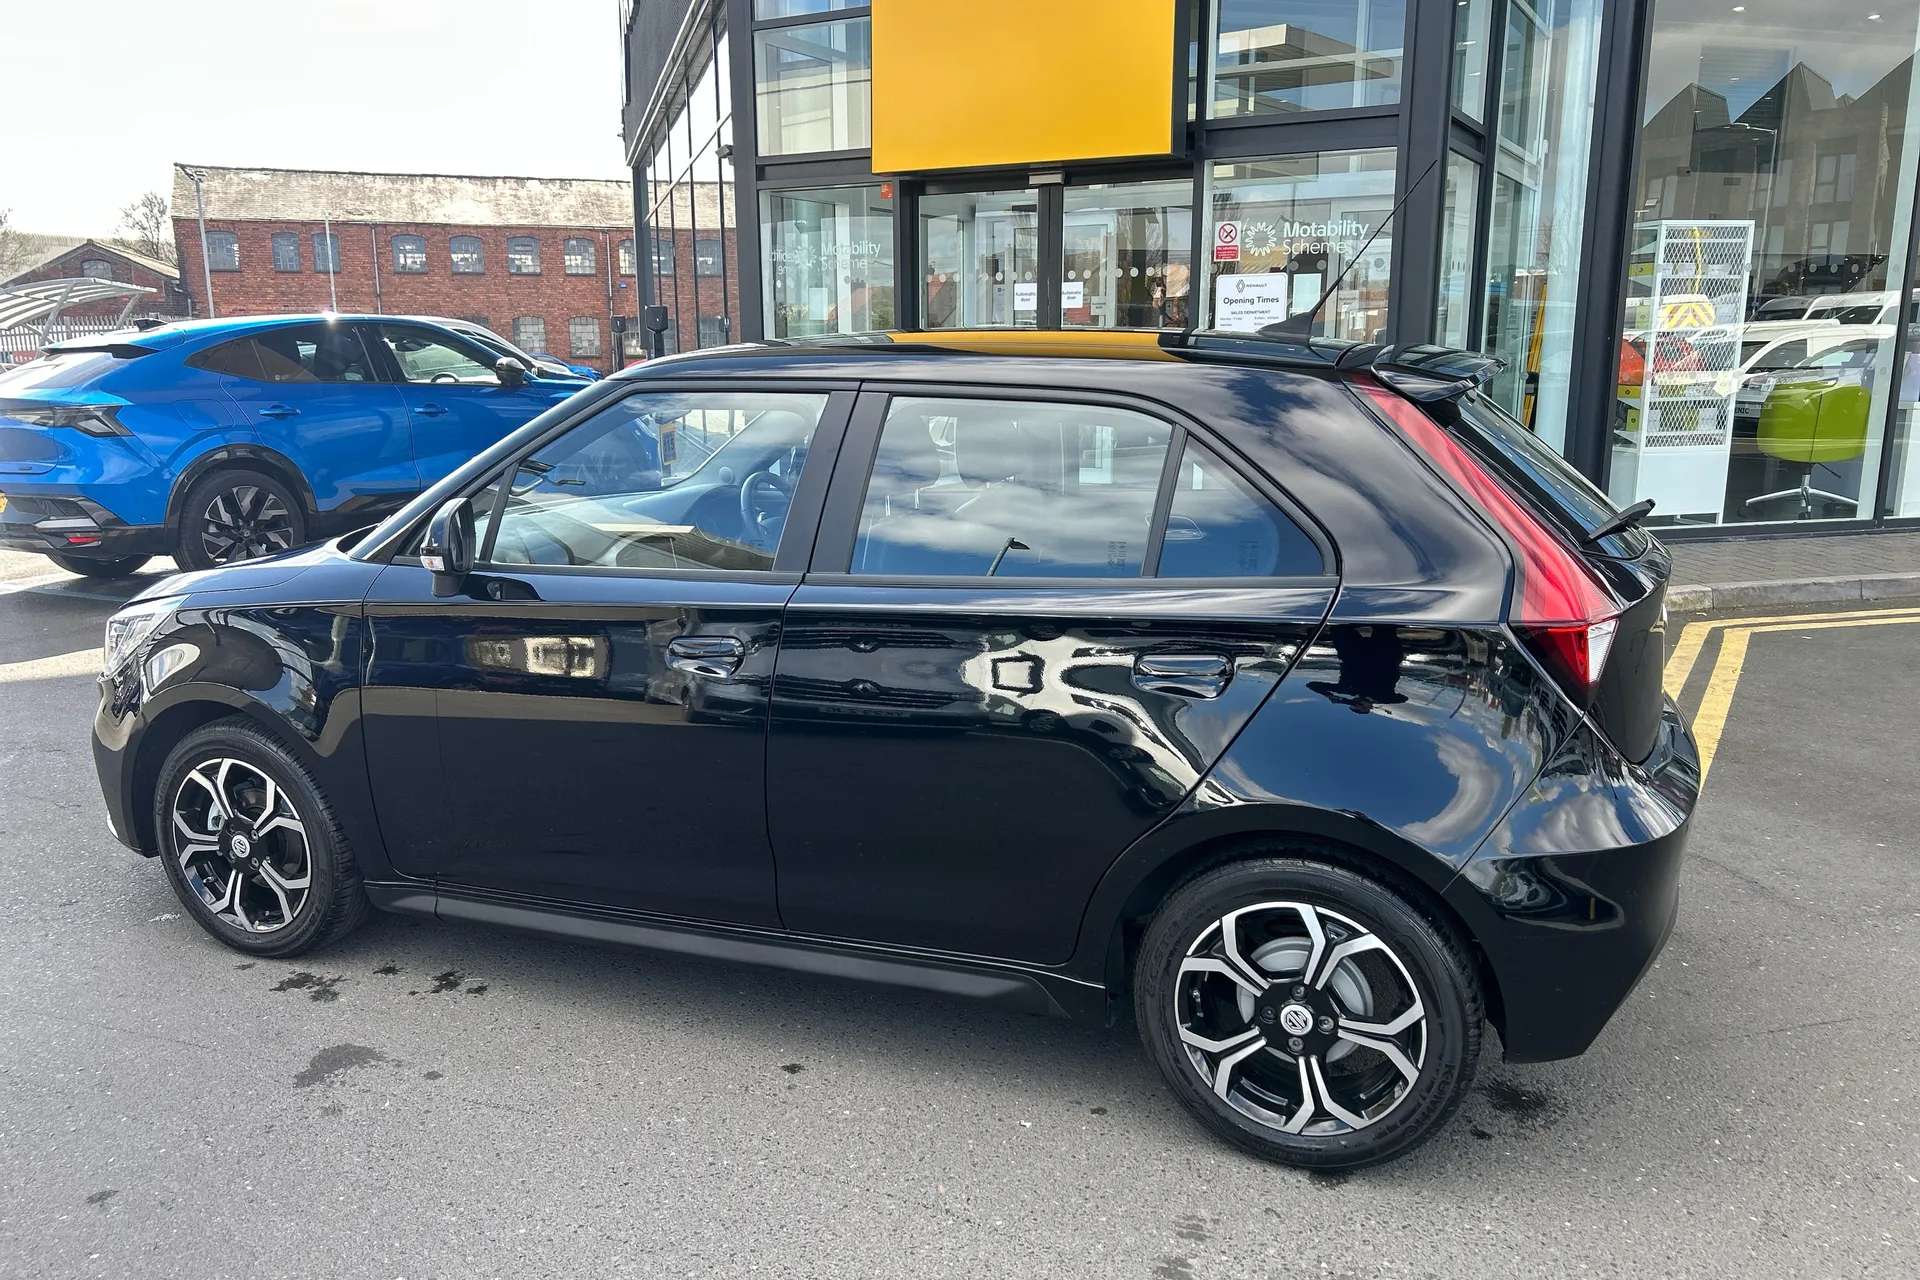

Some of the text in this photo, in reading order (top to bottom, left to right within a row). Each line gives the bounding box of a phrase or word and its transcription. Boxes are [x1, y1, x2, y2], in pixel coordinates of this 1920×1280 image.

[1283, 220, 1370, 240] Motability
[1283, 240, 1349, 255] Scheme
[1223, 296, 1280, 306] Opening Times
